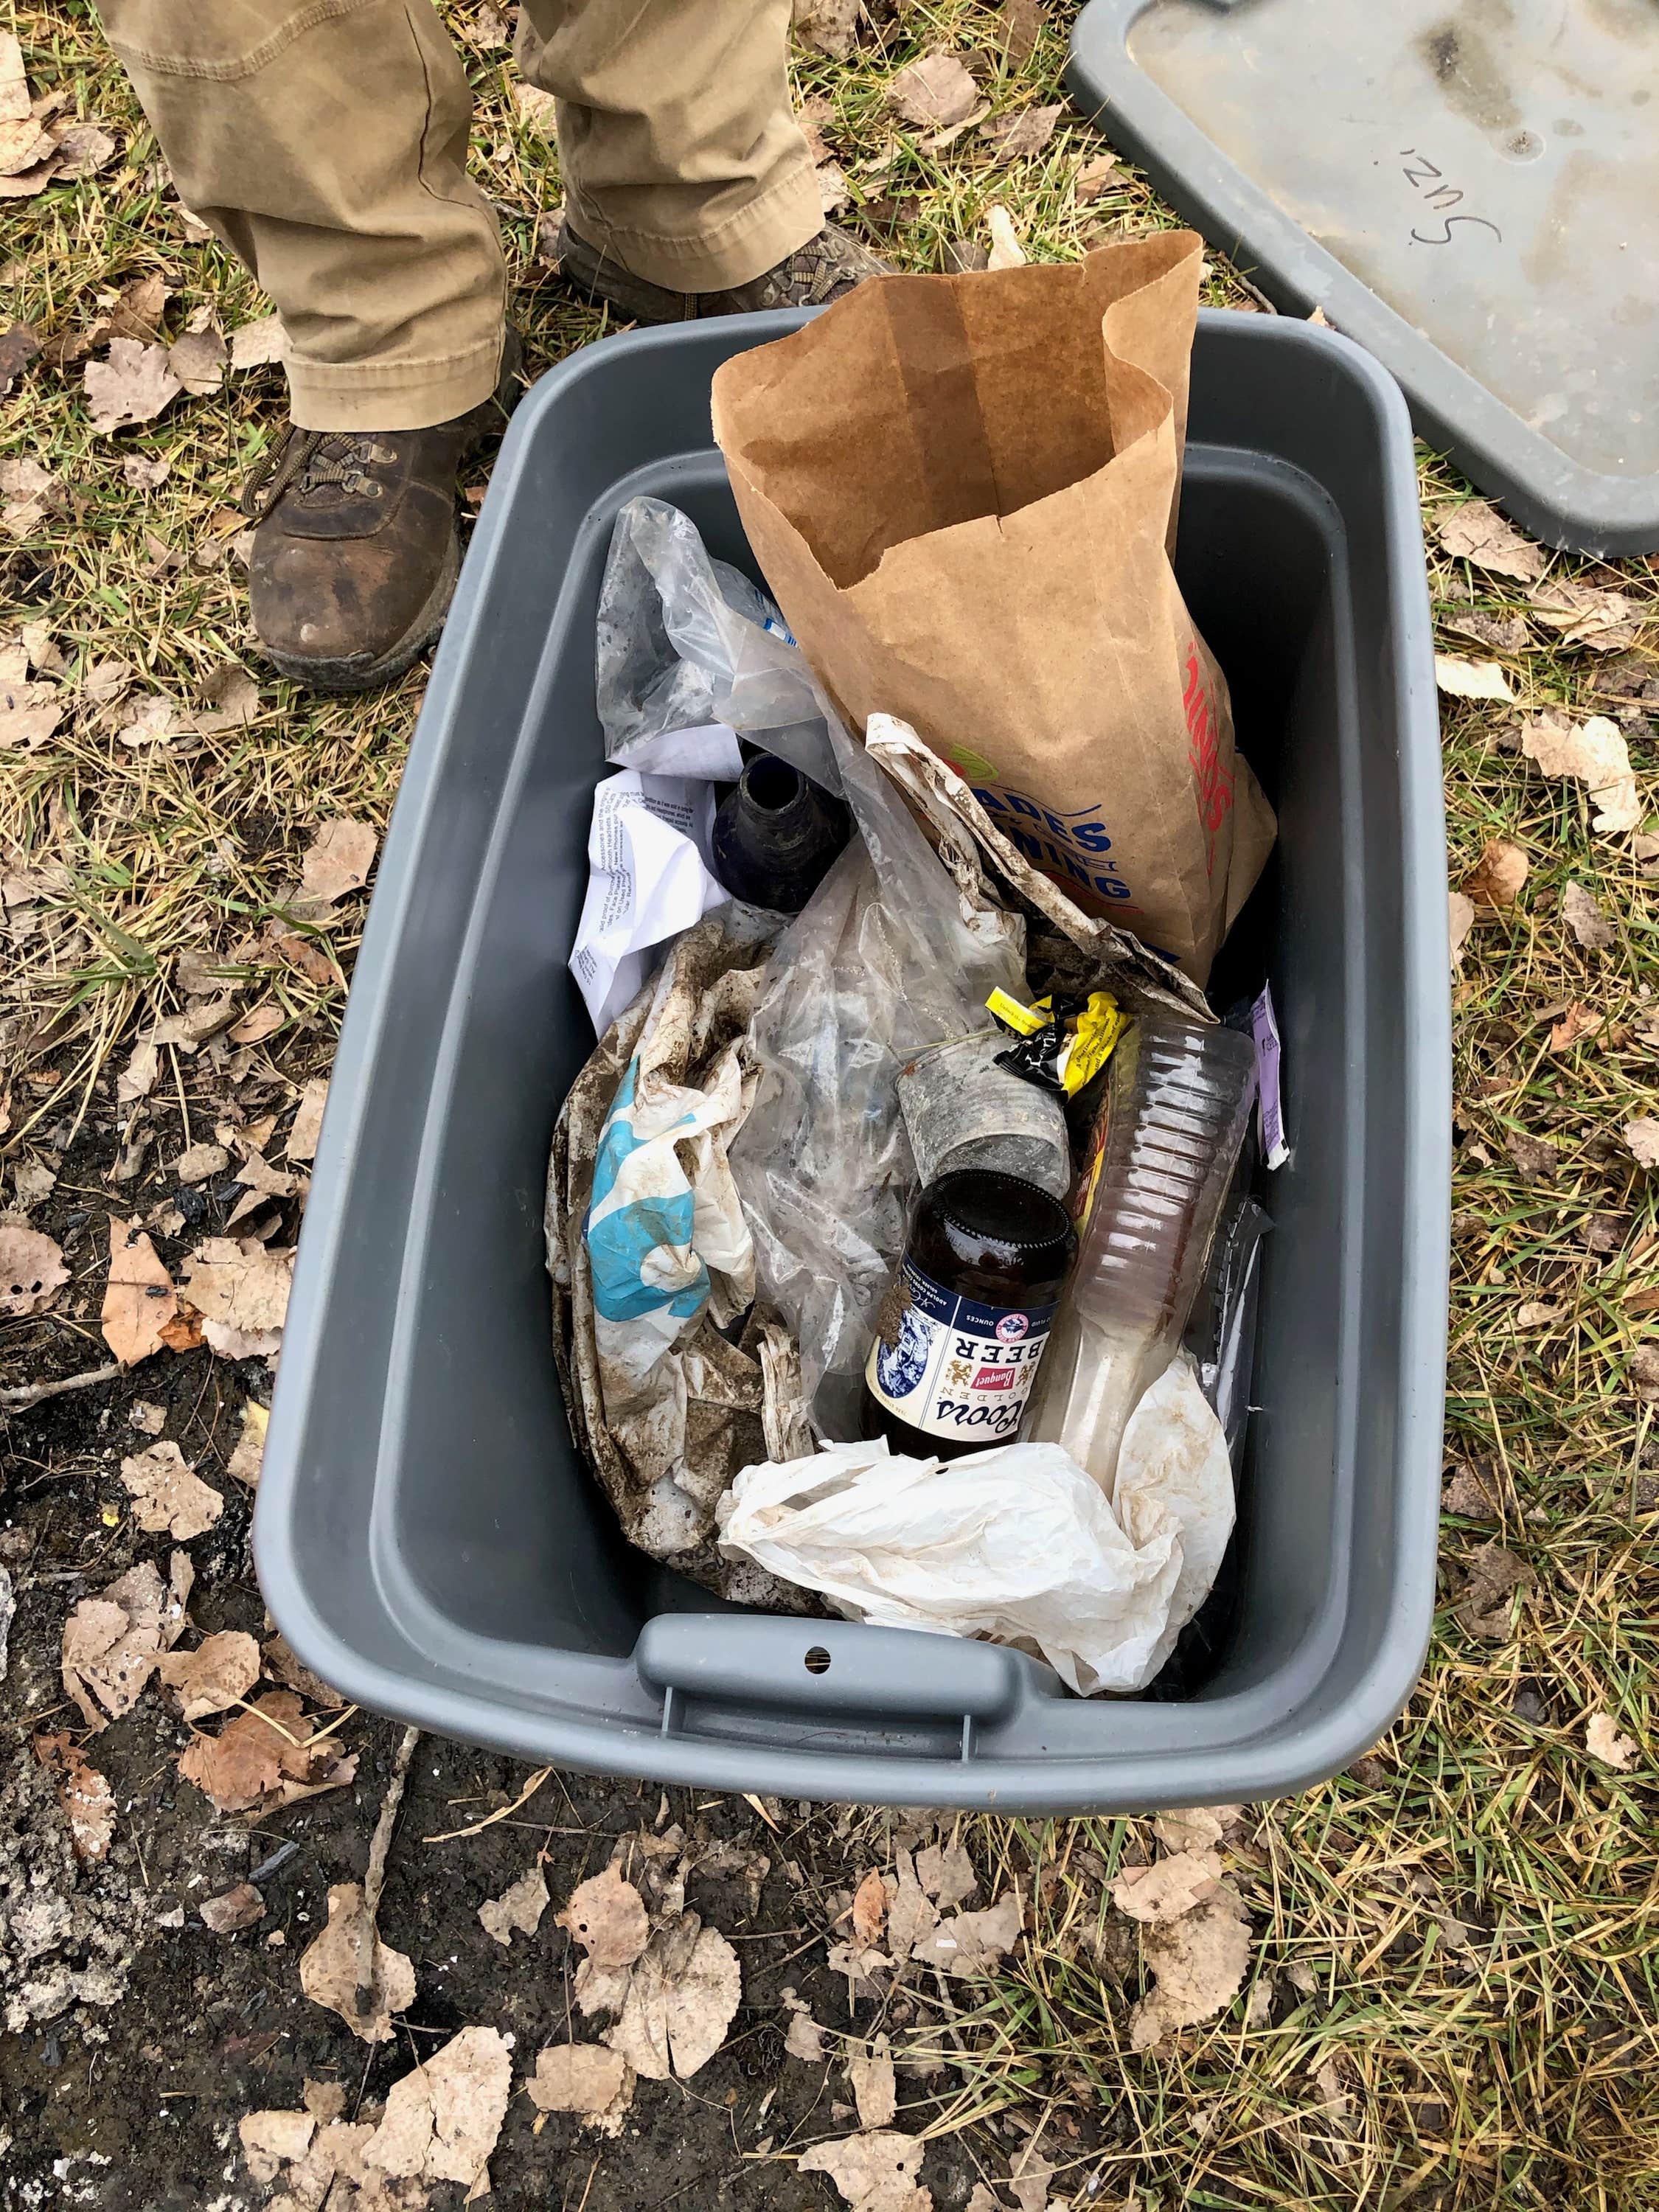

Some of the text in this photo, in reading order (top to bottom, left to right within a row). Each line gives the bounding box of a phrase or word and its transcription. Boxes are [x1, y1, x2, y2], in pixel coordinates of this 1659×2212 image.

[970, 787, 1112, 852] ADES
[1000, 824, 1132, 900] NING
[912, 1279, 927, 1293] COORS
[926, 1290, 947, 1307] ADOLPH
[966, 1314, 994, 1326] OUNCES
[956, 1338, 1043, 1364] BEER
[975, 1369, 1014, 1388] Banquet
[936, 1397, 1023, 1433] Coors
